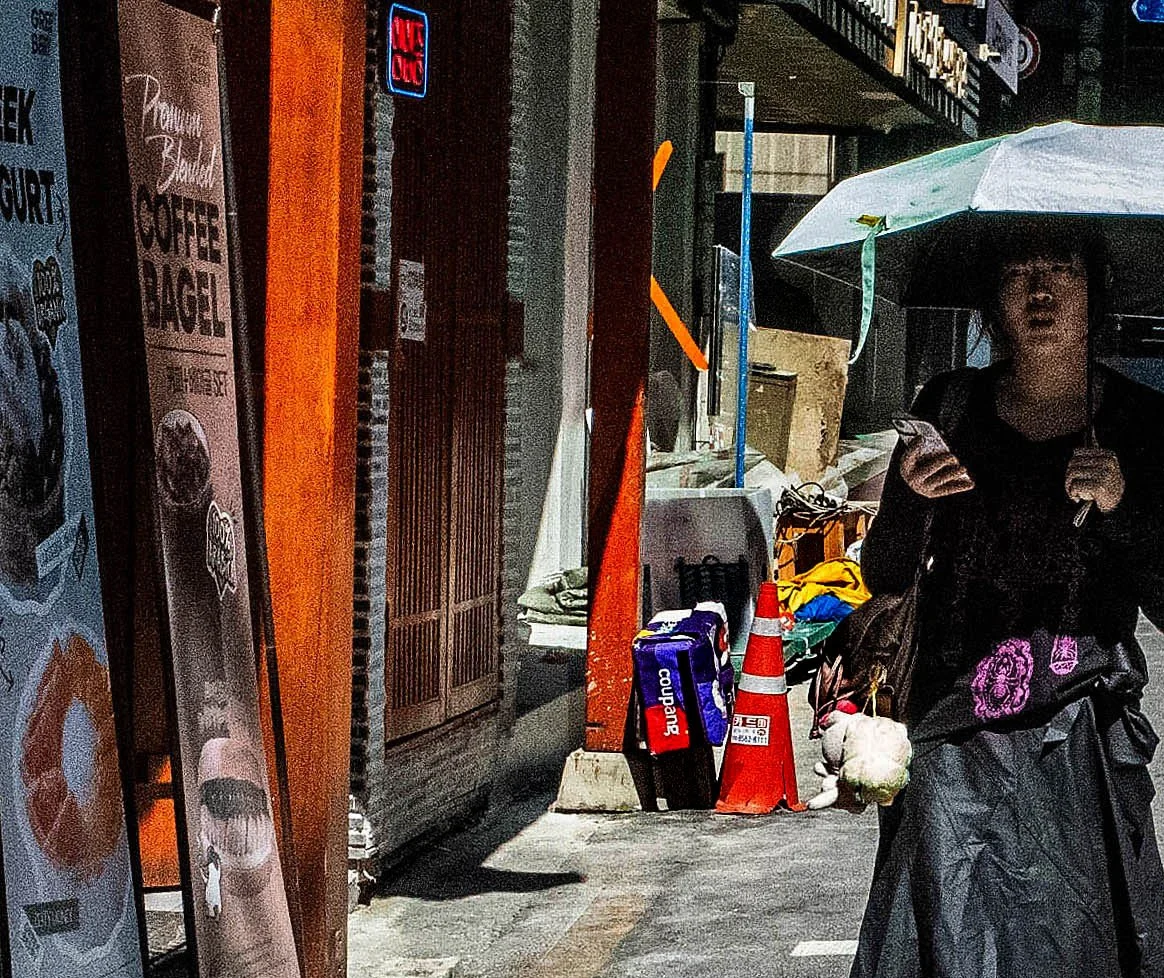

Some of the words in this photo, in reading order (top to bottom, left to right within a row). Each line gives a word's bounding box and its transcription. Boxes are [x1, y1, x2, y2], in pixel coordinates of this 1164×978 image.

[0, 85, 36, 146] EK
[134, 183, 221, 264] COFFEE
[141, 260, 226, 338] BAGEL
[658, 667, 680, 737] coupang
